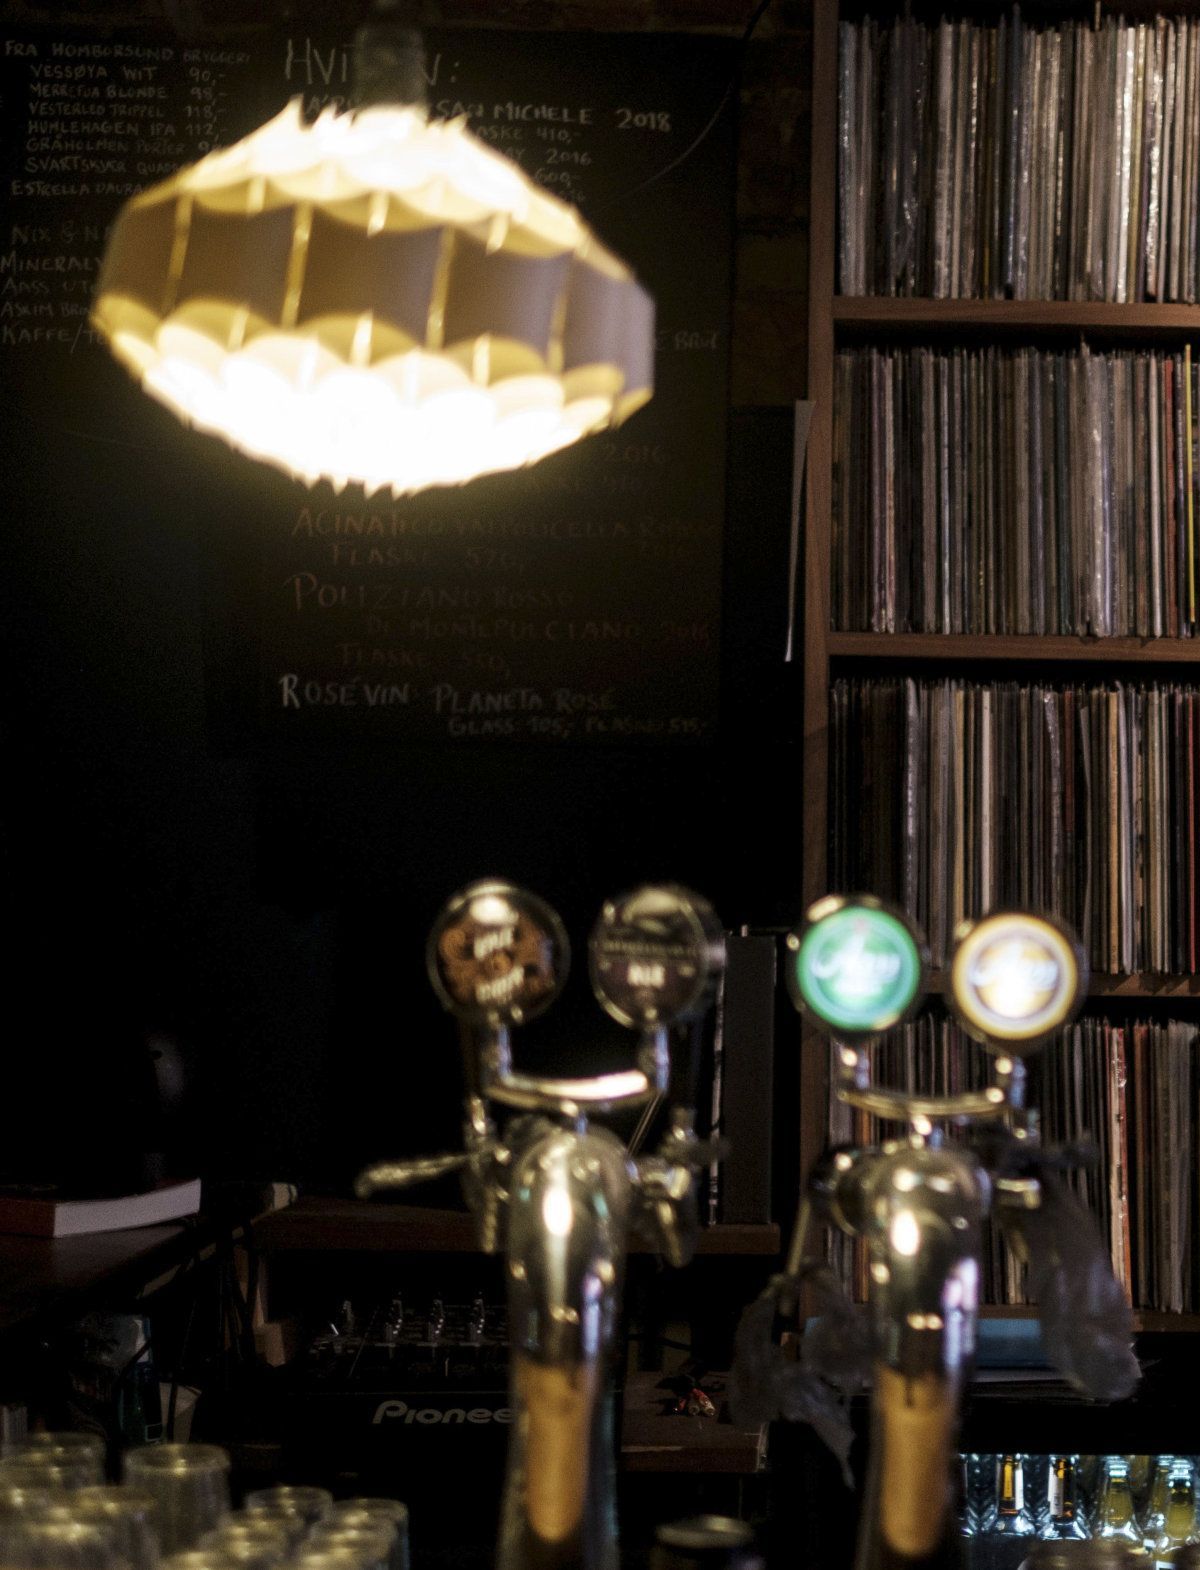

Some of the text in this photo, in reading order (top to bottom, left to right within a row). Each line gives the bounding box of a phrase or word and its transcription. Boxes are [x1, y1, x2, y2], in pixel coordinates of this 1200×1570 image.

[4, 39, 39, 57] FRA
[121, 65, 158, 80] WIT
[105, 83, 169, 99] BLONDE
[492, 101, 594, 126] MICHELE
[614, 106, 673, 134] 2018
[27, 119, 140, 135] HUMLEHAGEN
[10, 179, 91, 197] ESTRELLA
[430, 682, 544, 714] PLANETA
[371, 1399, 514, 1427] Pionee
